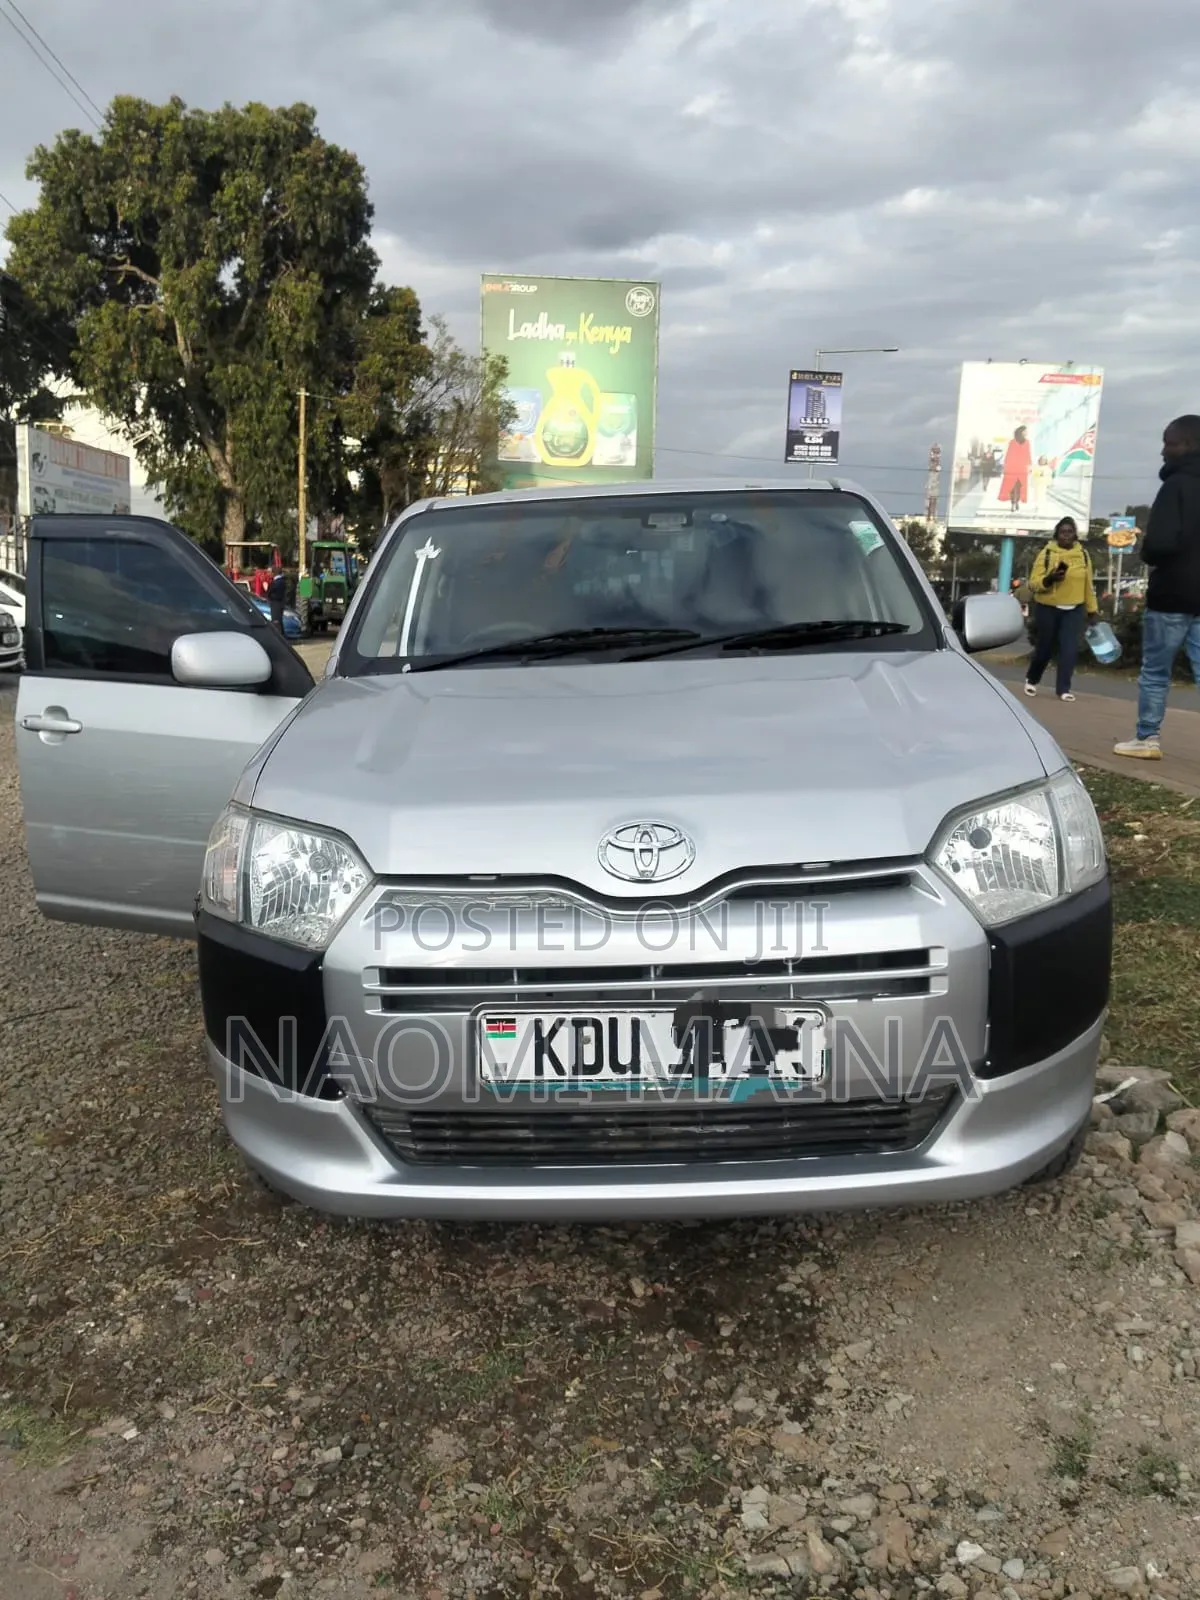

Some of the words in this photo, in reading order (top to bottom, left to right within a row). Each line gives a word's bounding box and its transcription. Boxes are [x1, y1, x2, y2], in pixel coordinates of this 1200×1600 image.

[507, 308, 566, 341] Ladha
[579, 312, 632, 355] Kenya
[534, 1016, 641, 1077] KDU
